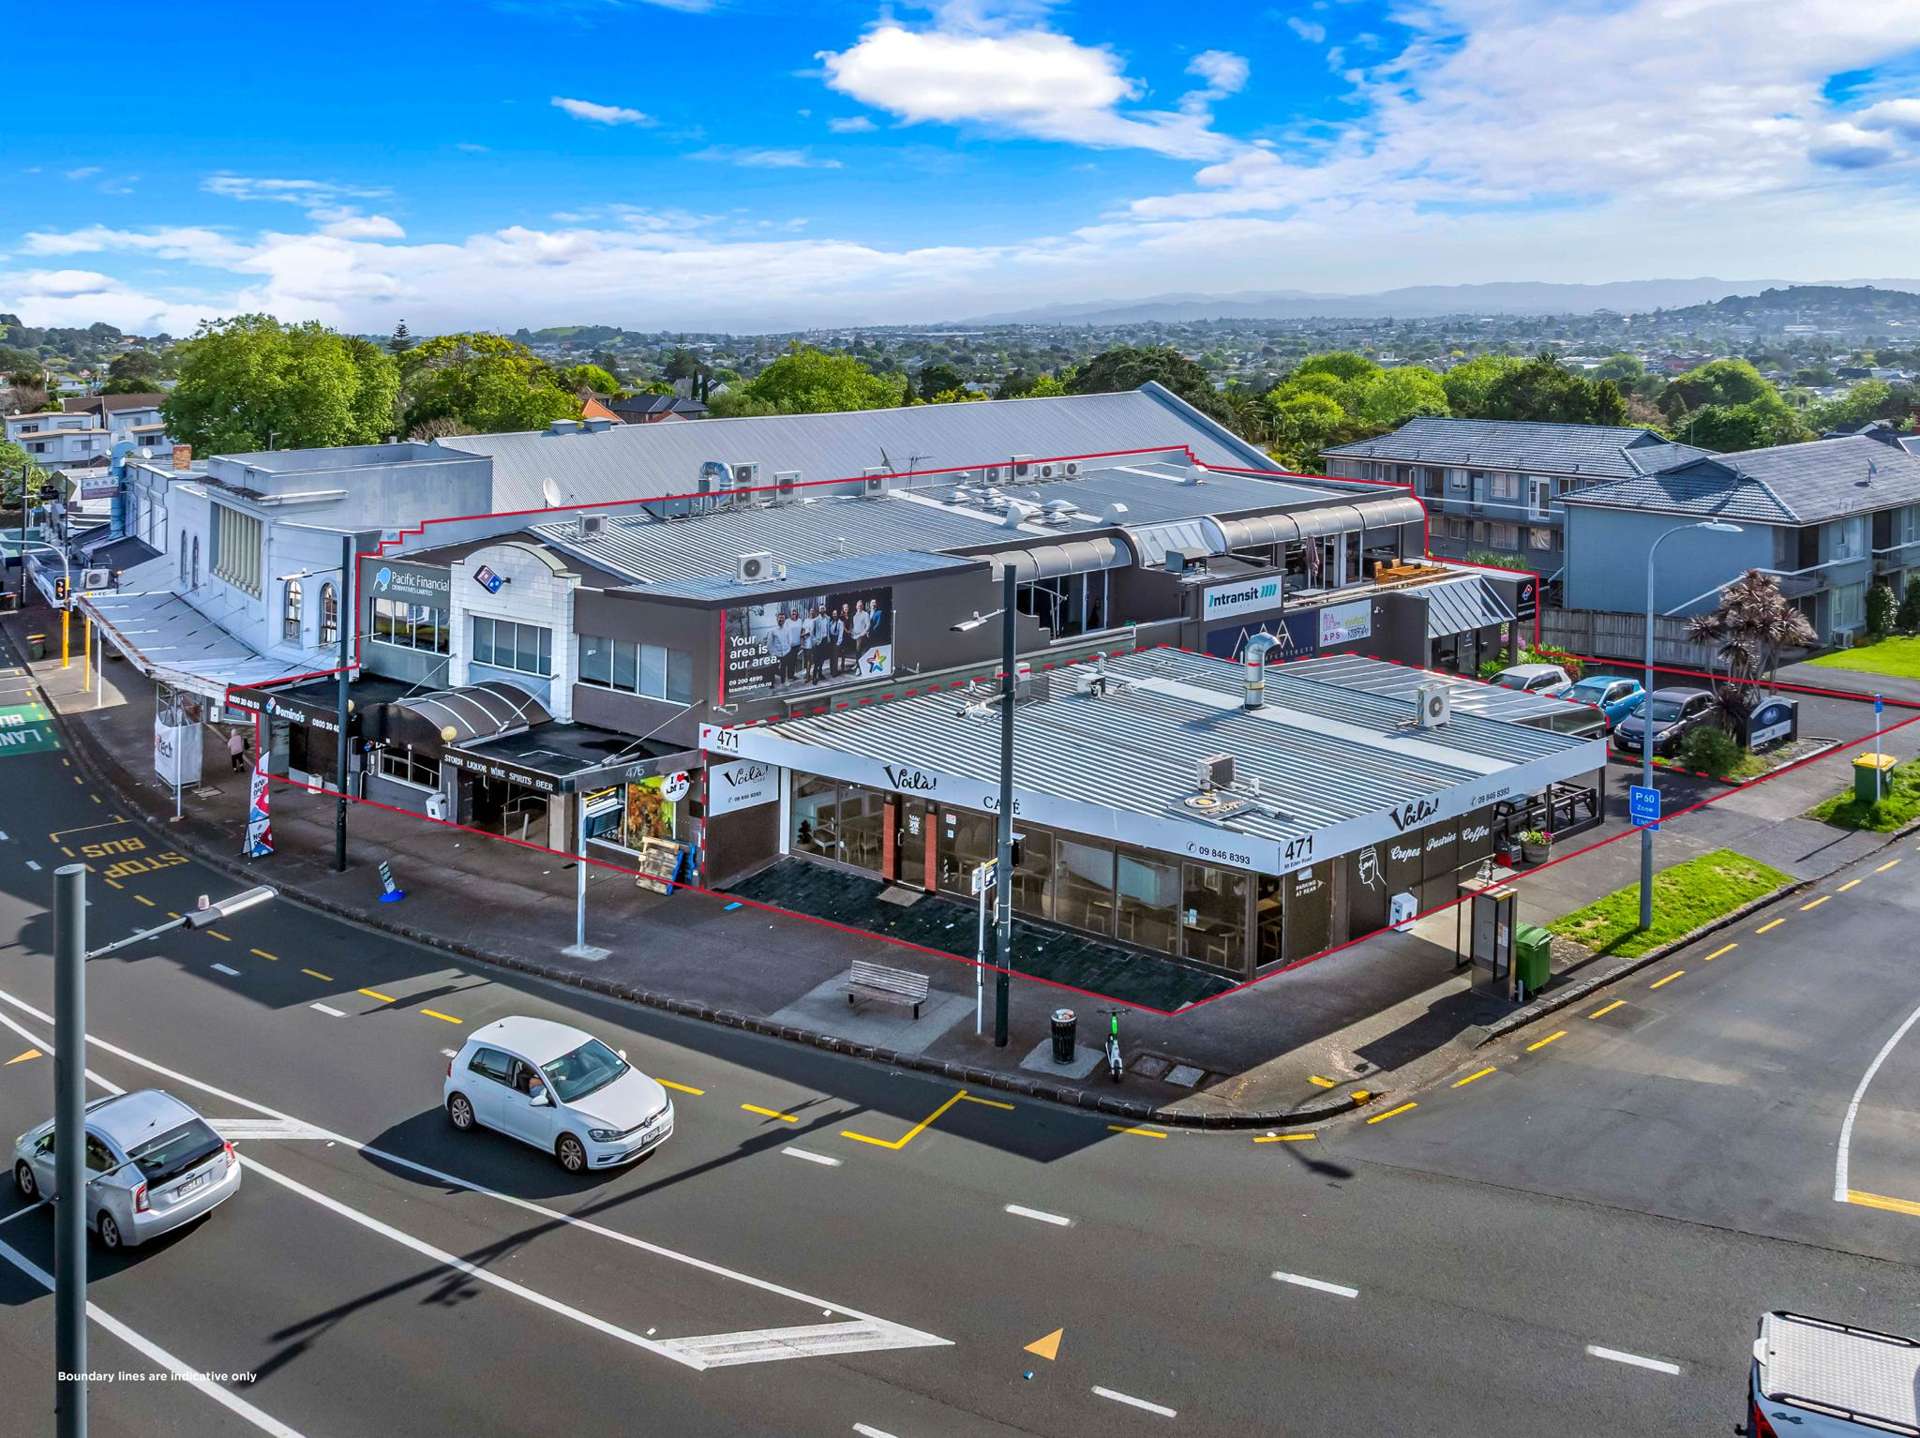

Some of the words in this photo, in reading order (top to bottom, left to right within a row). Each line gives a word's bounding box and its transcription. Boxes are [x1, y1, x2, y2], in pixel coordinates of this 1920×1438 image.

[391, 571, 415, 587] Pacific
[416, 574, 450, 593] Financial
[730, 635, 756, 647] Your
[730, 647, 755, 660] area
[758, 643, 768, 655] is
[730, 659, 750, 670] our
[752, 655, 780, 667] area.
[275, 704, 305, 723] Domino's
[717, 730, 738, 748] 471
[467, 760, 487, 773] LIQUOR
[490, 767, 506, 778] WINE
[508, 772, 532, 785] SPIRITS
[535, 779, 553, 791] BEER
[883, 765, 937, 790] Voilà!
[983, 795, 1020, 815] CAÉ
[1389, 798, 1439, 832] Voilà!
[1426, 832, 1457, 851] Pastries
[1462, 825, 1490, 843] Coffee
[81, 837, 146, 858] BUS
[1199, 846, 1209, 855] 09
[1211, 848, 1227, 860] 846
[1229, 852, 1250, 865] 8393
[1284, 834, 1313, 860] 471
[103, 852, 190, 879] STOP
[1296, 880, 1316, 891] PARKING
[1303, 886, 1316, 895] REAR
